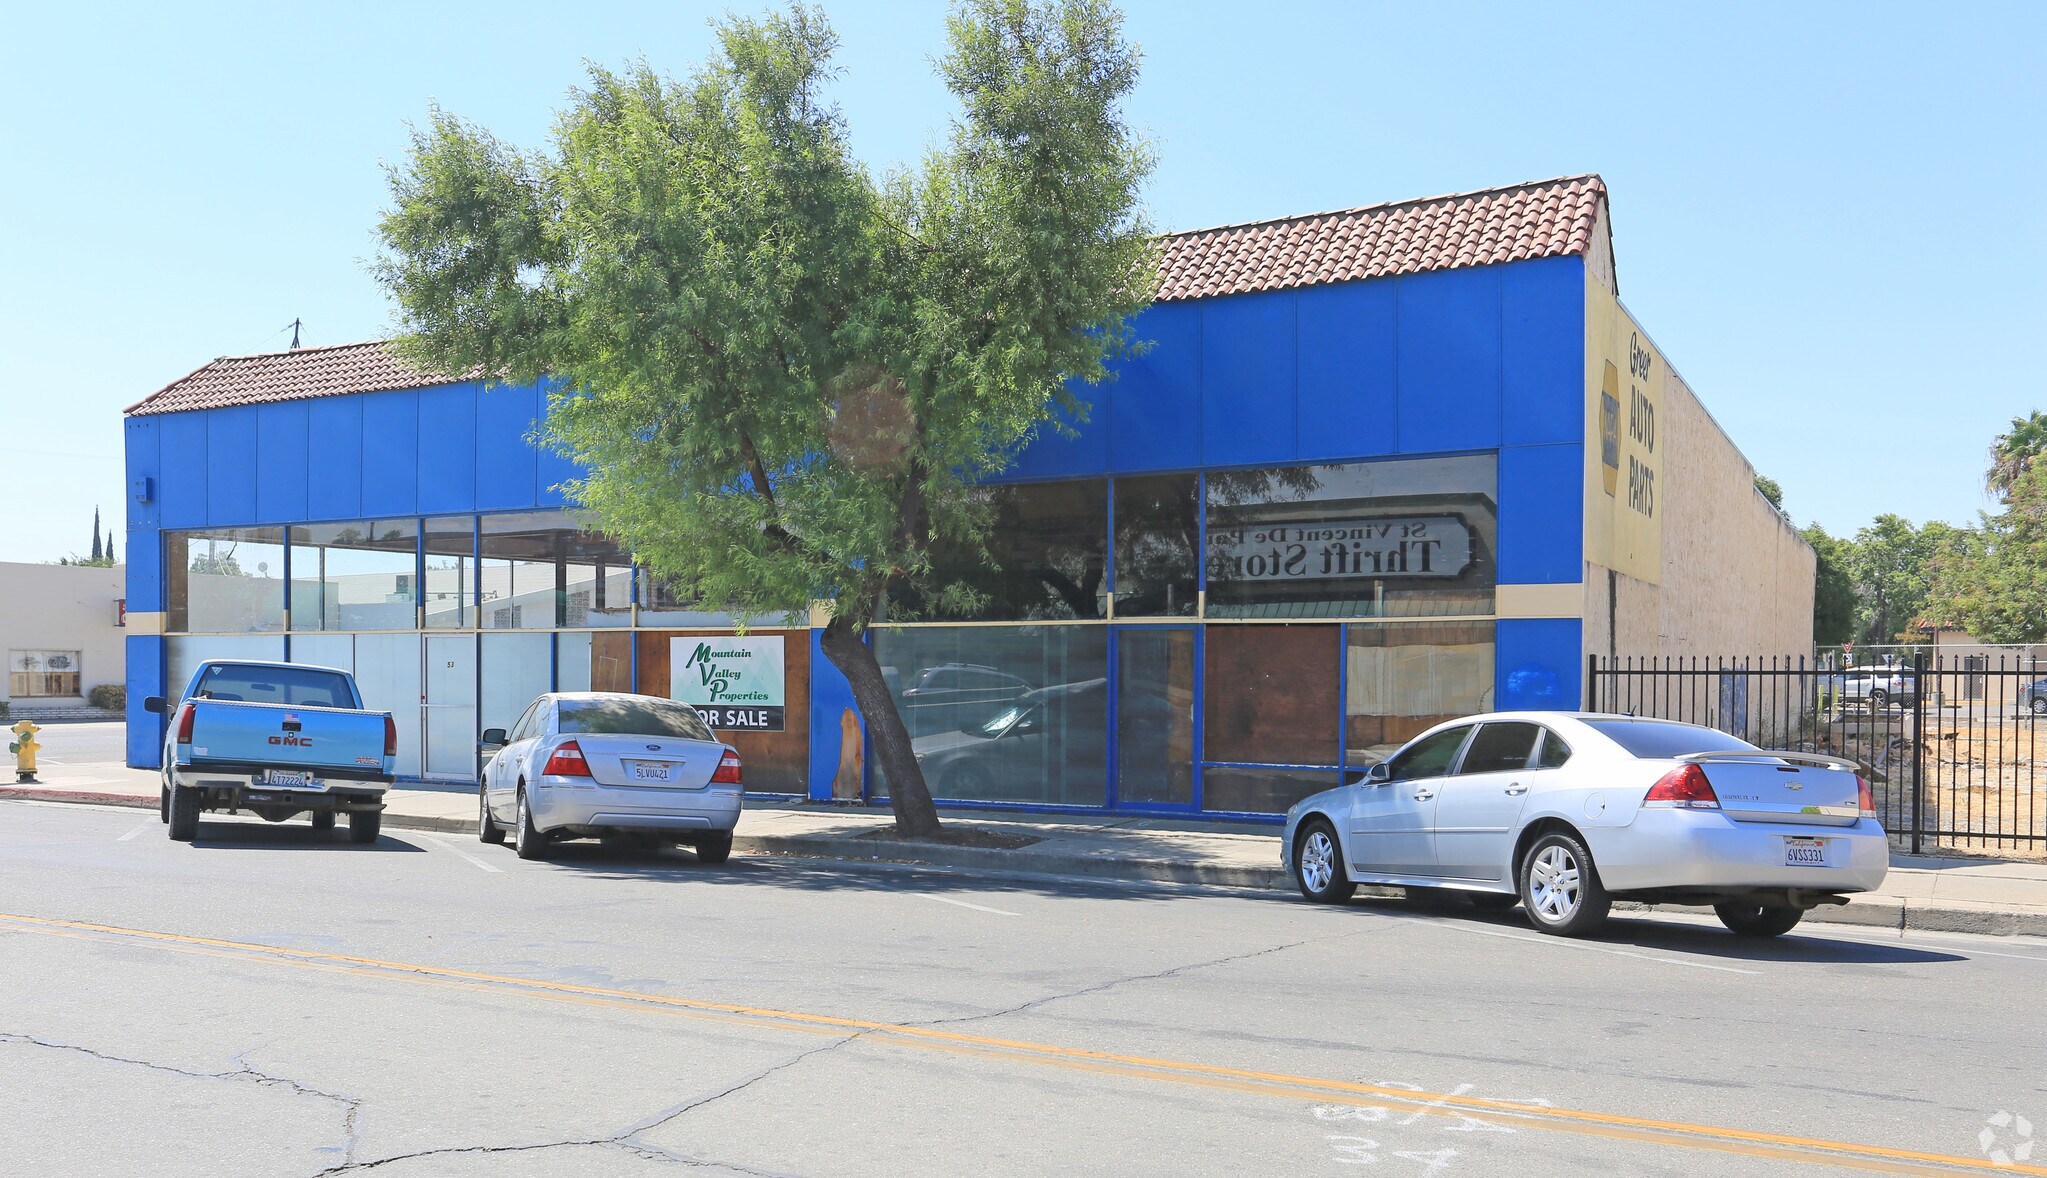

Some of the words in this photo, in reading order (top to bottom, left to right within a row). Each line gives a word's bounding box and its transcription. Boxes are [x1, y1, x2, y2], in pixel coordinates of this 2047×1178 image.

[1629, 384, 1655, 454] AUTO
[1628, 454, 1655, 519] PARTS
[685, 642, 752, 669] Mountain
[699, 662, 742, 687] Valley
[709, 678, 769, 703] Properties
[697, 709, 720, 726] OR
[726, 710, 769, 727] SALE
[267, 736, 313, 747] GMC
[636, 768, 668, 780] 5LVU421
[1787, 848, 1825, 862] 6VSS331
